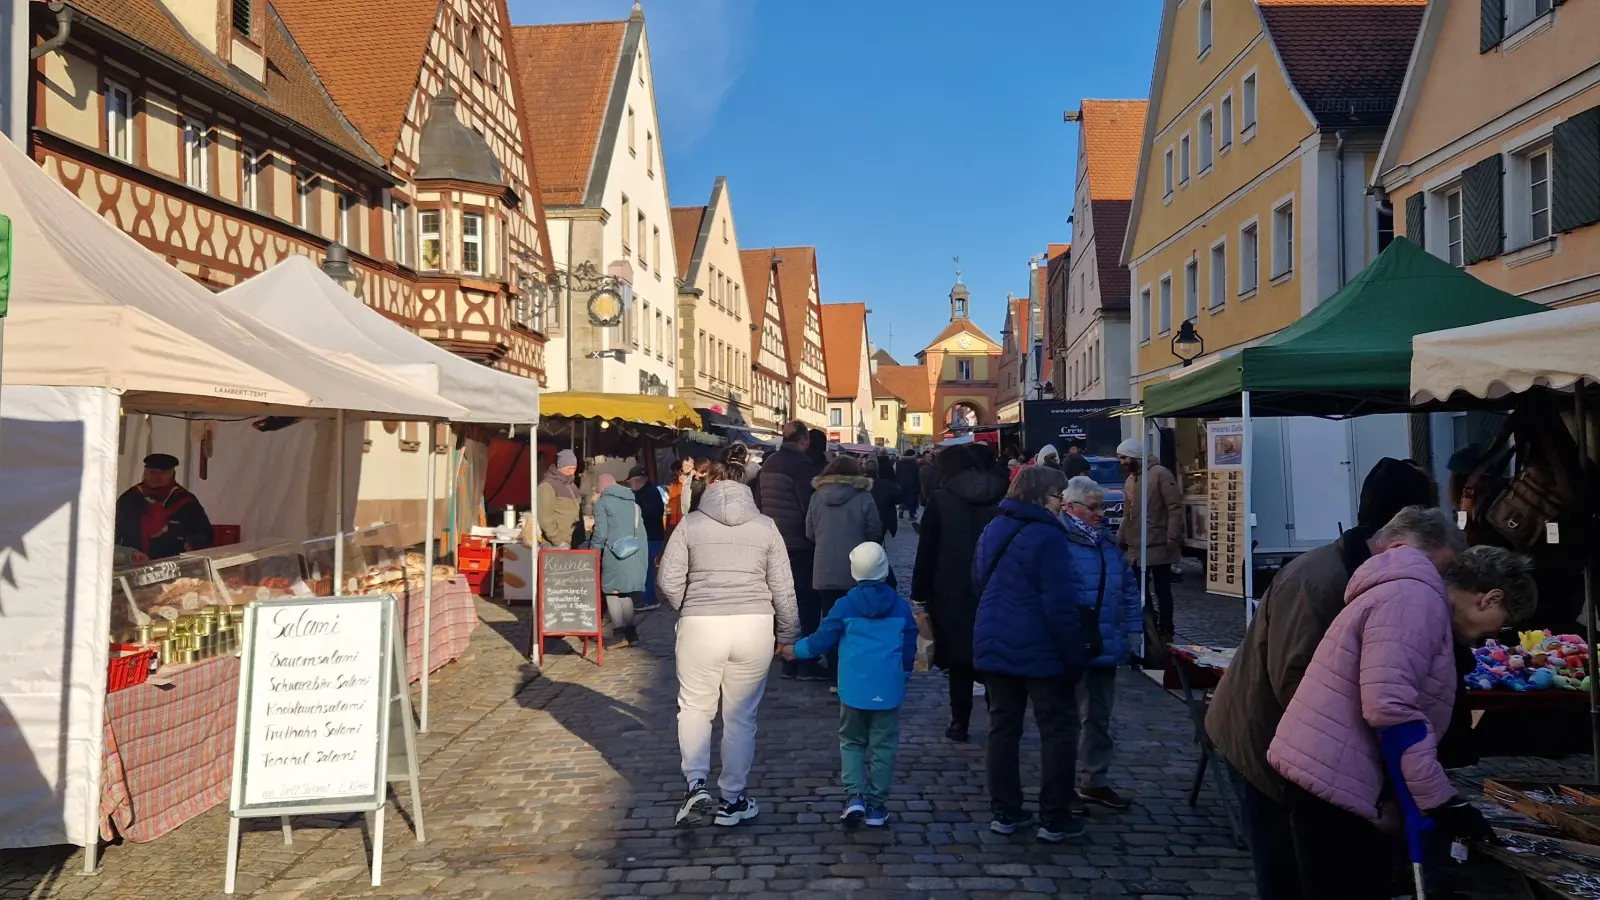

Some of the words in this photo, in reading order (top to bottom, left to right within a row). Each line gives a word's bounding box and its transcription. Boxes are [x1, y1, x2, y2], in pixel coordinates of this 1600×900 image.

[214, 386, 268, 398] LAMBERT-TENT
[269, 608, 341, 639] Salami
[270, 649, 359, 668] Bauernsalami
[336, 674, 372, 690] Salami
[266, 700, 366, 717] Knoblauchsalami
[264, 724, 318, 741] Truthahn
[324, 721, 363, 738] Salami
[262, 751, 311, 768] Fenchel
[316, 750, 357, 763] Salami
